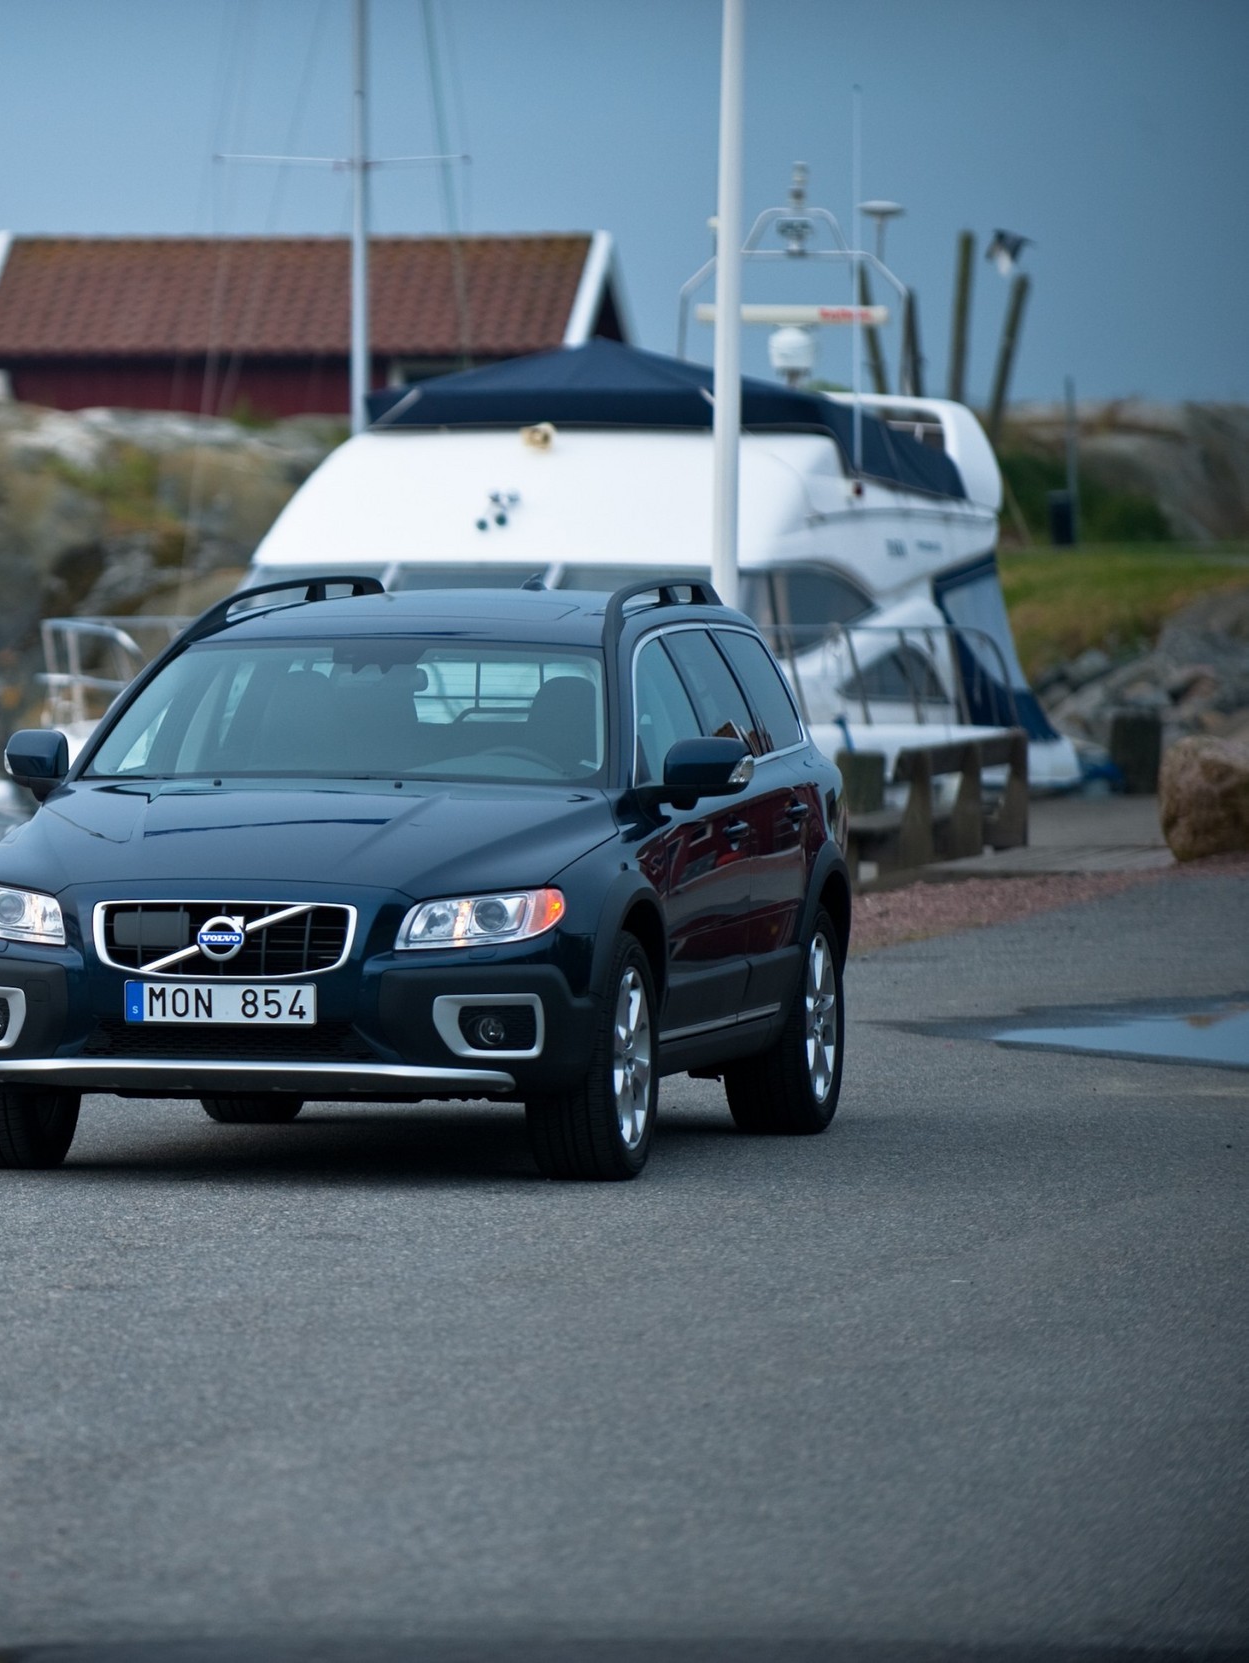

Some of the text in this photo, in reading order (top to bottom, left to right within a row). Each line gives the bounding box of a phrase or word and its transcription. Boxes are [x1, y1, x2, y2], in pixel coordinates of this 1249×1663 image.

[201, 934, 240, 942] VOLVO
[132, 986, 307, 1019] S MON 854
